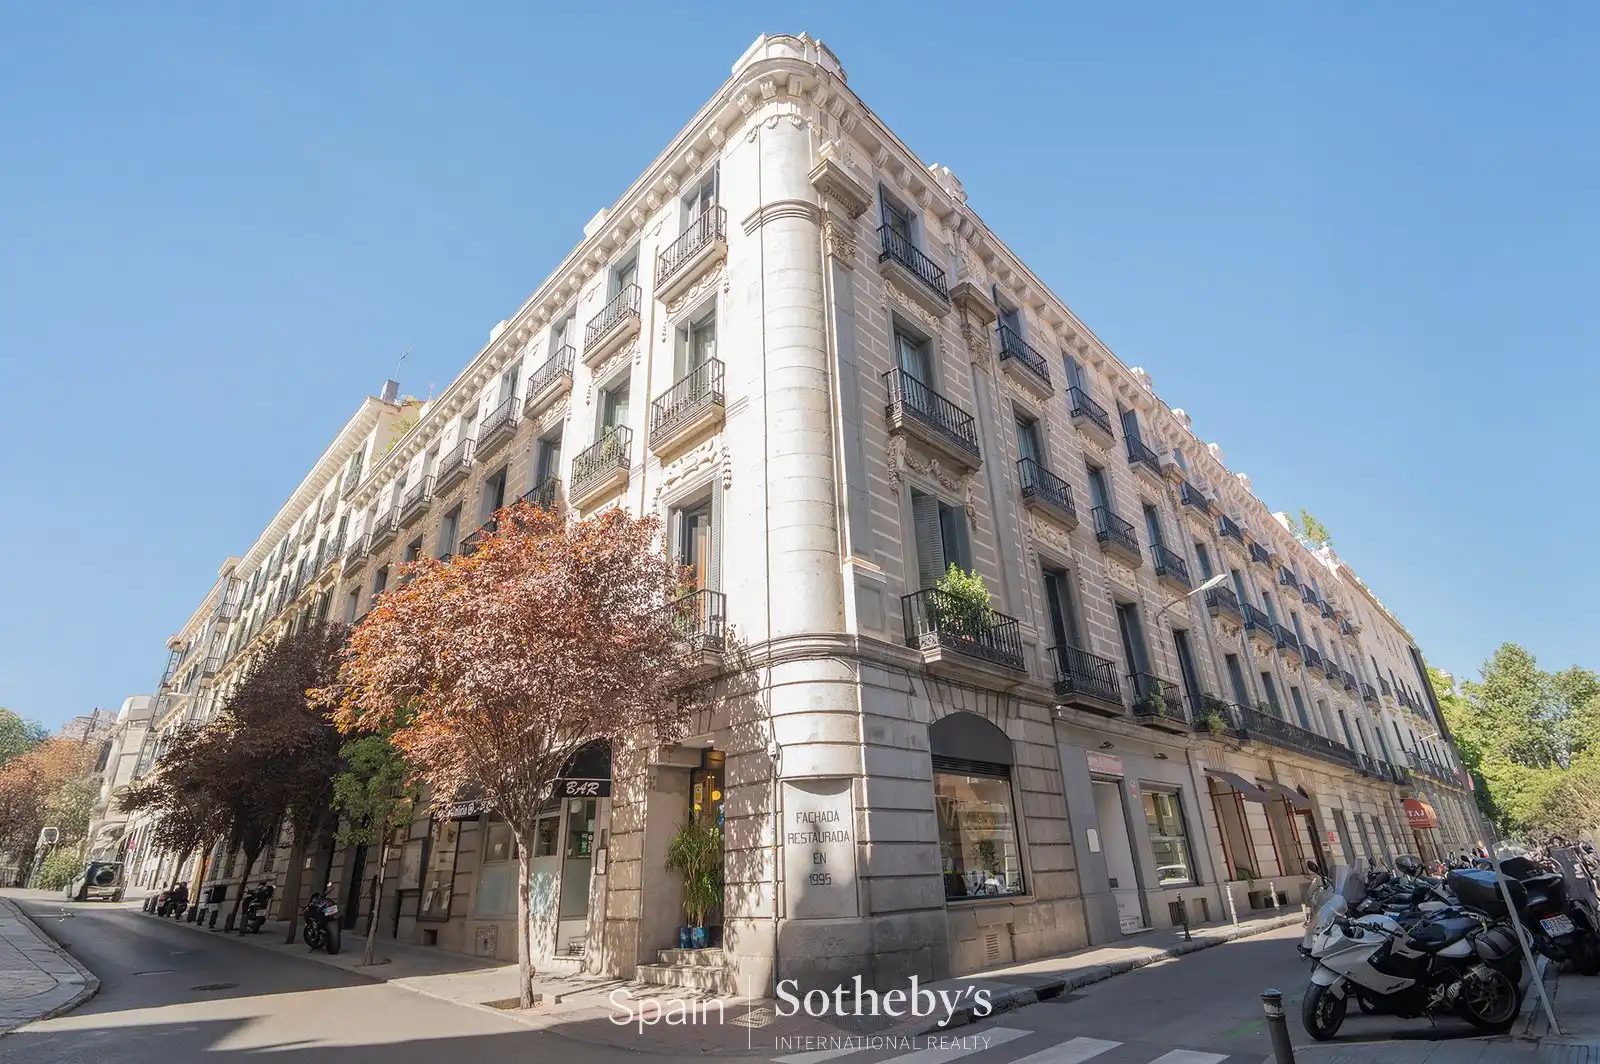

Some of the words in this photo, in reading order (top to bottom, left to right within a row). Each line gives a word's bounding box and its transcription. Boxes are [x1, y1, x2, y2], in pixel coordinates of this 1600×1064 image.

[565, 781, 600, 796] BAR
[796, 811, 840, 824] FACHADA
[787, 830, 850, 844] RESTAURADA
[813, 852, 827, 865] EN
[809, 872, 832, 886] 1995
